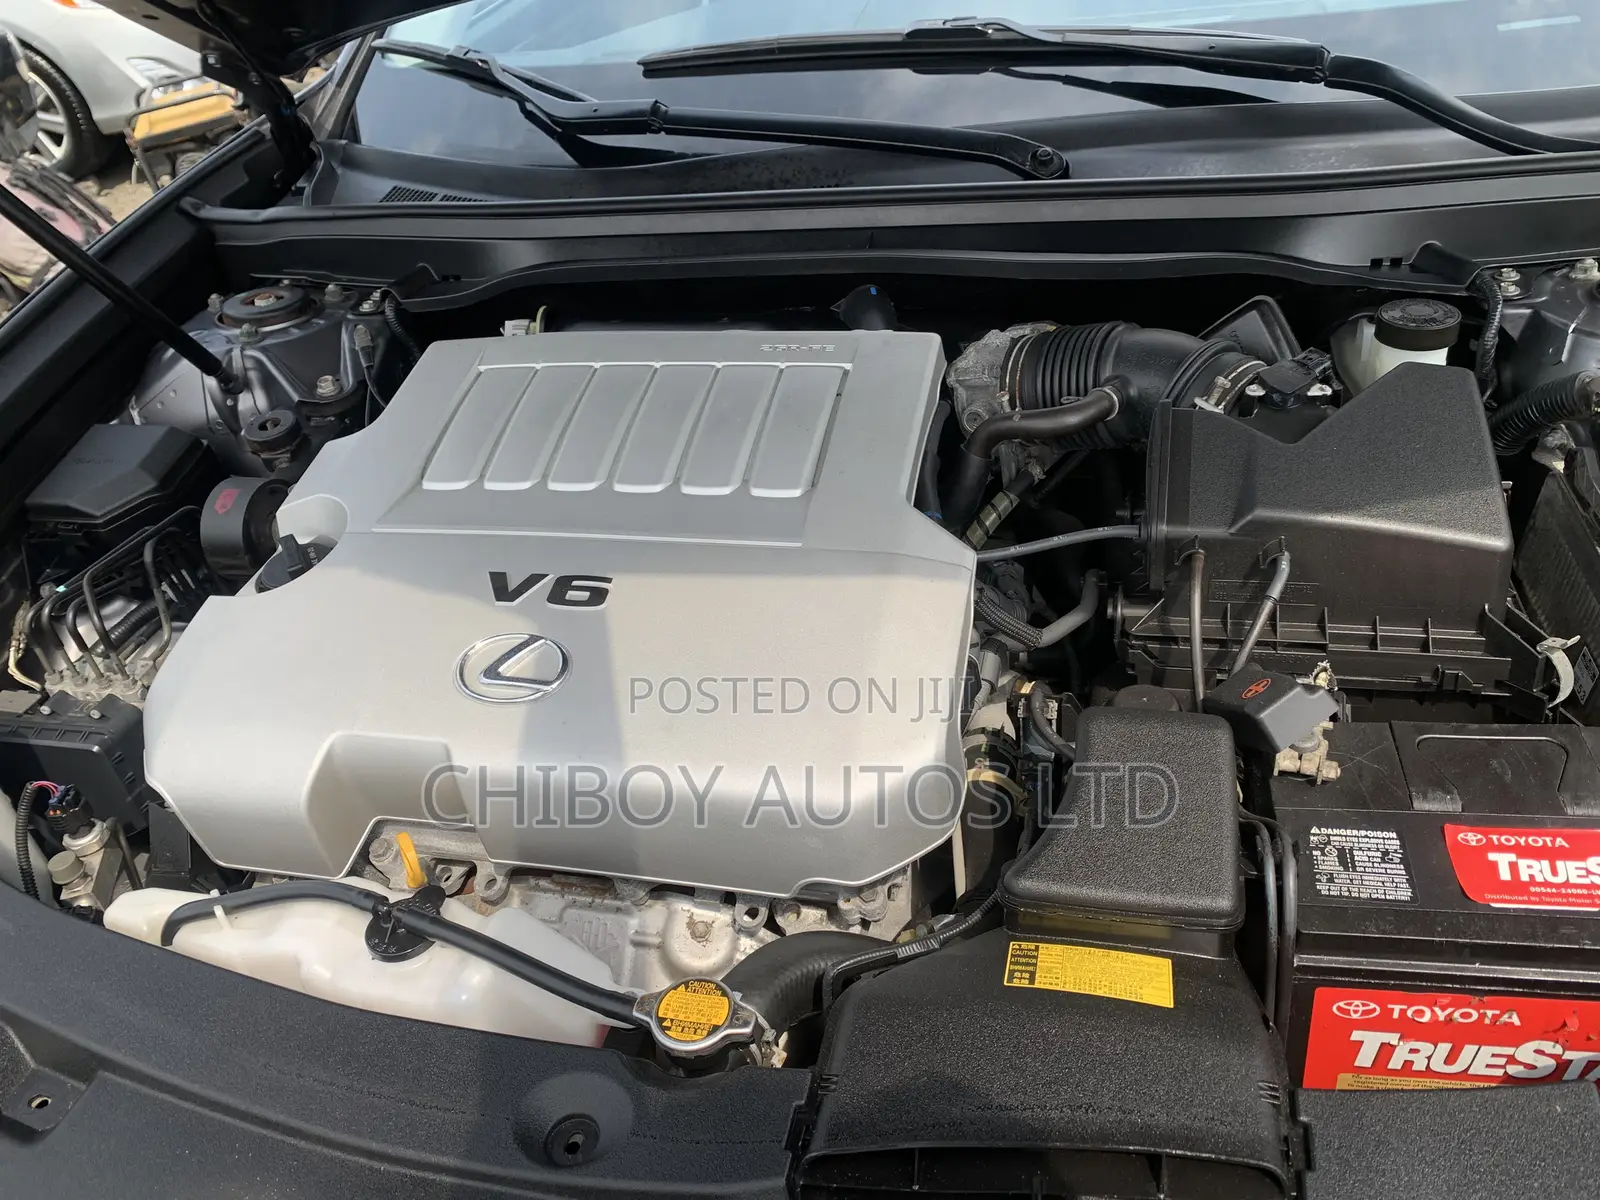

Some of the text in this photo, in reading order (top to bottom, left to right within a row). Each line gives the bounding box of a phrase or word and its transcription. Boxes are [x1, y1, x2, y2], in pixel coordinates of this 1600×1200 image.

[488, 571, 613, 609] V6
[1320, 828, 1397, 838] DANGER/POISON
[1488, 834, 1570, 848] TOYOTA
[1484, 893, 1528, 902] Distributed
[1542, 896, 1567, 904] Toyota
[688, 980, 716, 990] CAUTION
[686, 986, 722, 996] ATTENTION
[1387, 1004, 1521, 1026] TOYOTA
